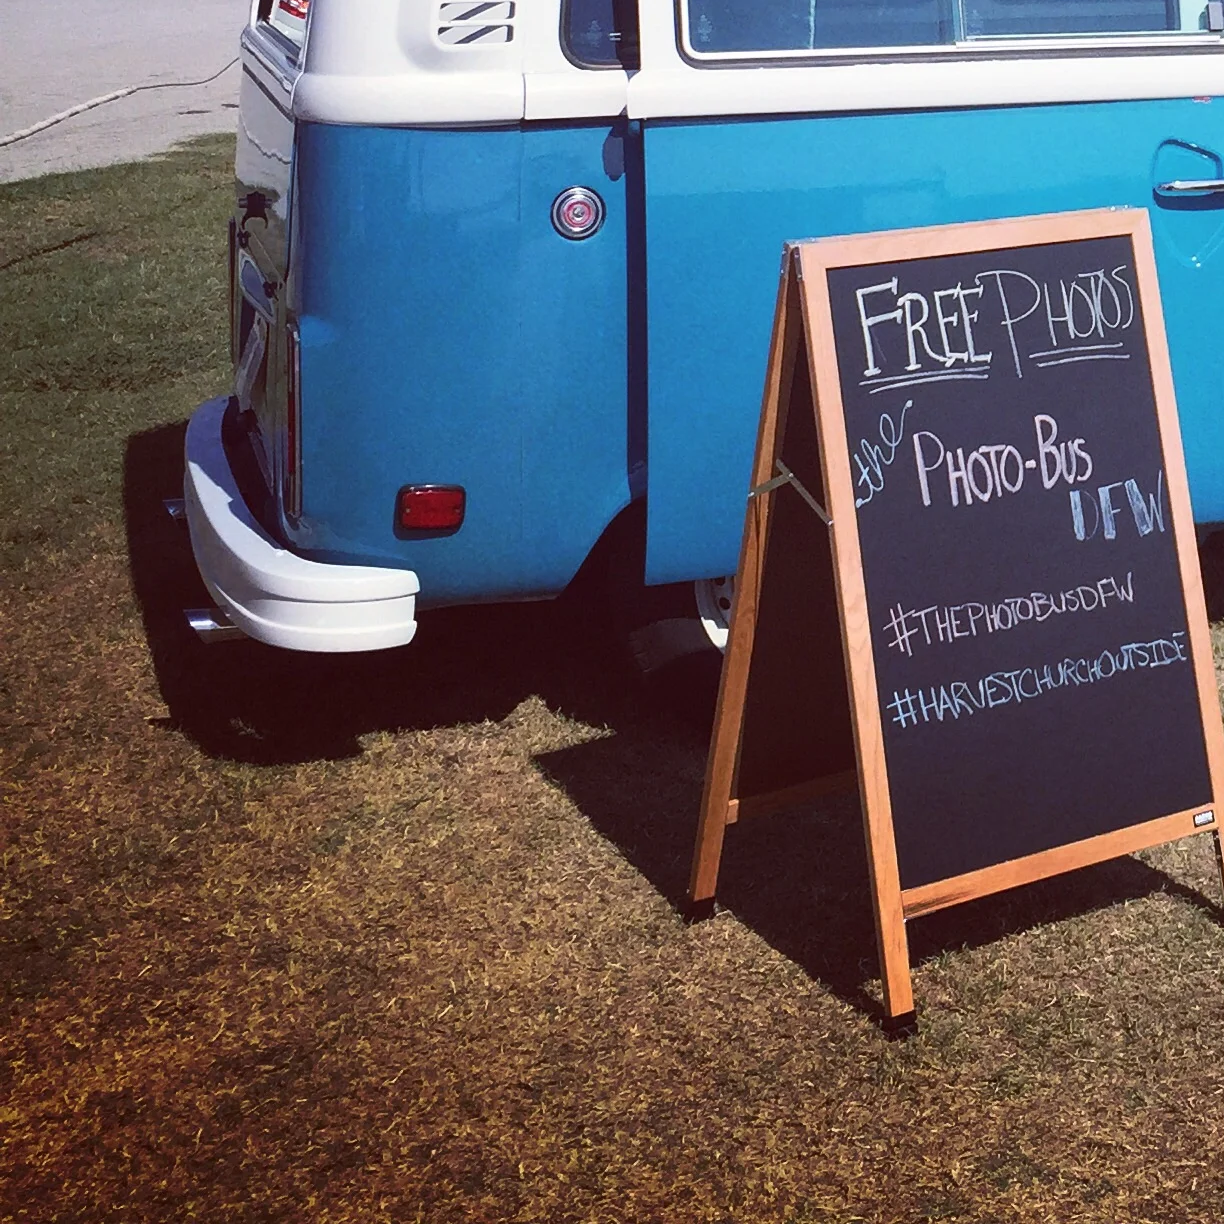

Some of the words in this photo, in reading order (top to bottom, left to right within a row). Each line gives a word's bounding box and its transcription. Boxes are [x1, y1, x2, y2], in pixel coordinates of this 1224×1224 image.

[856, 276, 992, 376] FREE
[975, 265, 1135, 378] PHOTOS
[855, 399, 913, 509] the
[1069, 468, 1166, 542] DFW
[883, 571, 1135, 657] #THEPHOTOBUSDFW
[886, 631, 1188, 728] #HARVESTCHURCHOUTSIDE
